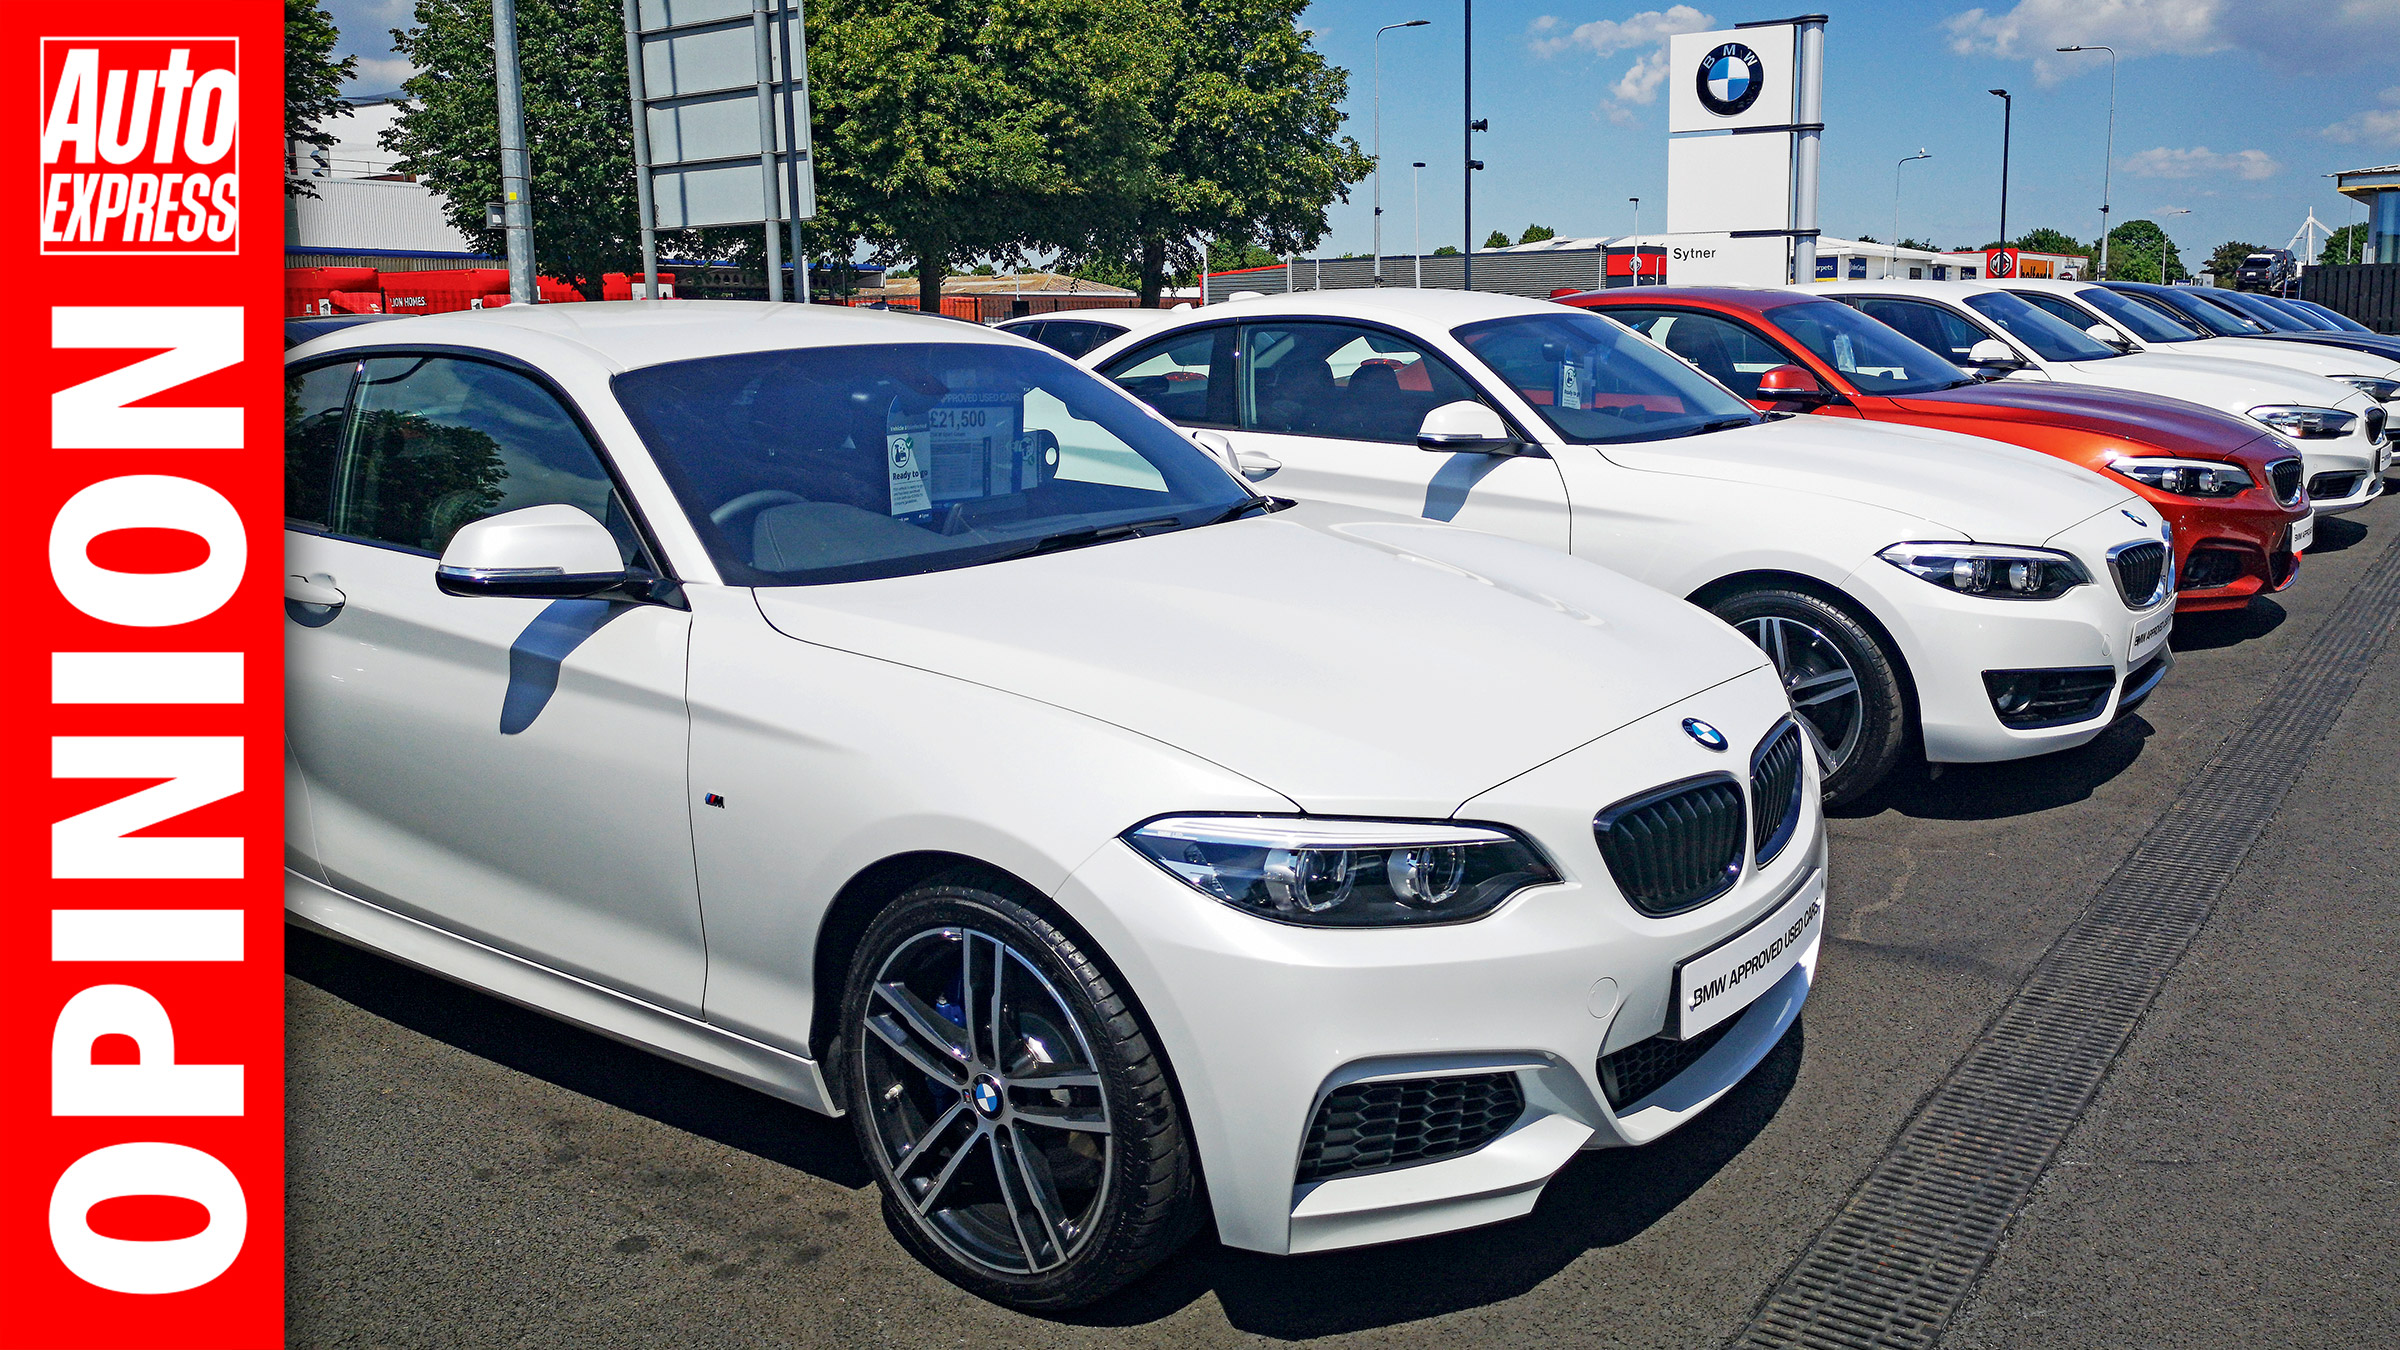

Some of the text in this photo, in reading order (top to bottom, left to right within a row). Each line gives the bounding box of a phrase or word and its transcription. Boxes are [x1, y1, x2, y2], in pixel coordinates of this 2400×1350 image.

[1702, 44, 1758, 70] BMW
[1673, 247, 1717, 262] Sytner
[1816, 264, 1834, 273] arpets
[941, 392, 1020, 403] PPROVED USED CARS
[930, 410, 986, 431] £21,500
[892, 471, 911, 480] Ready
[1693, 974, 1727, 1008] BMW
[1728, 937, 1783, 990] APPROVED
[1784, 916, 1803, 950] USED
